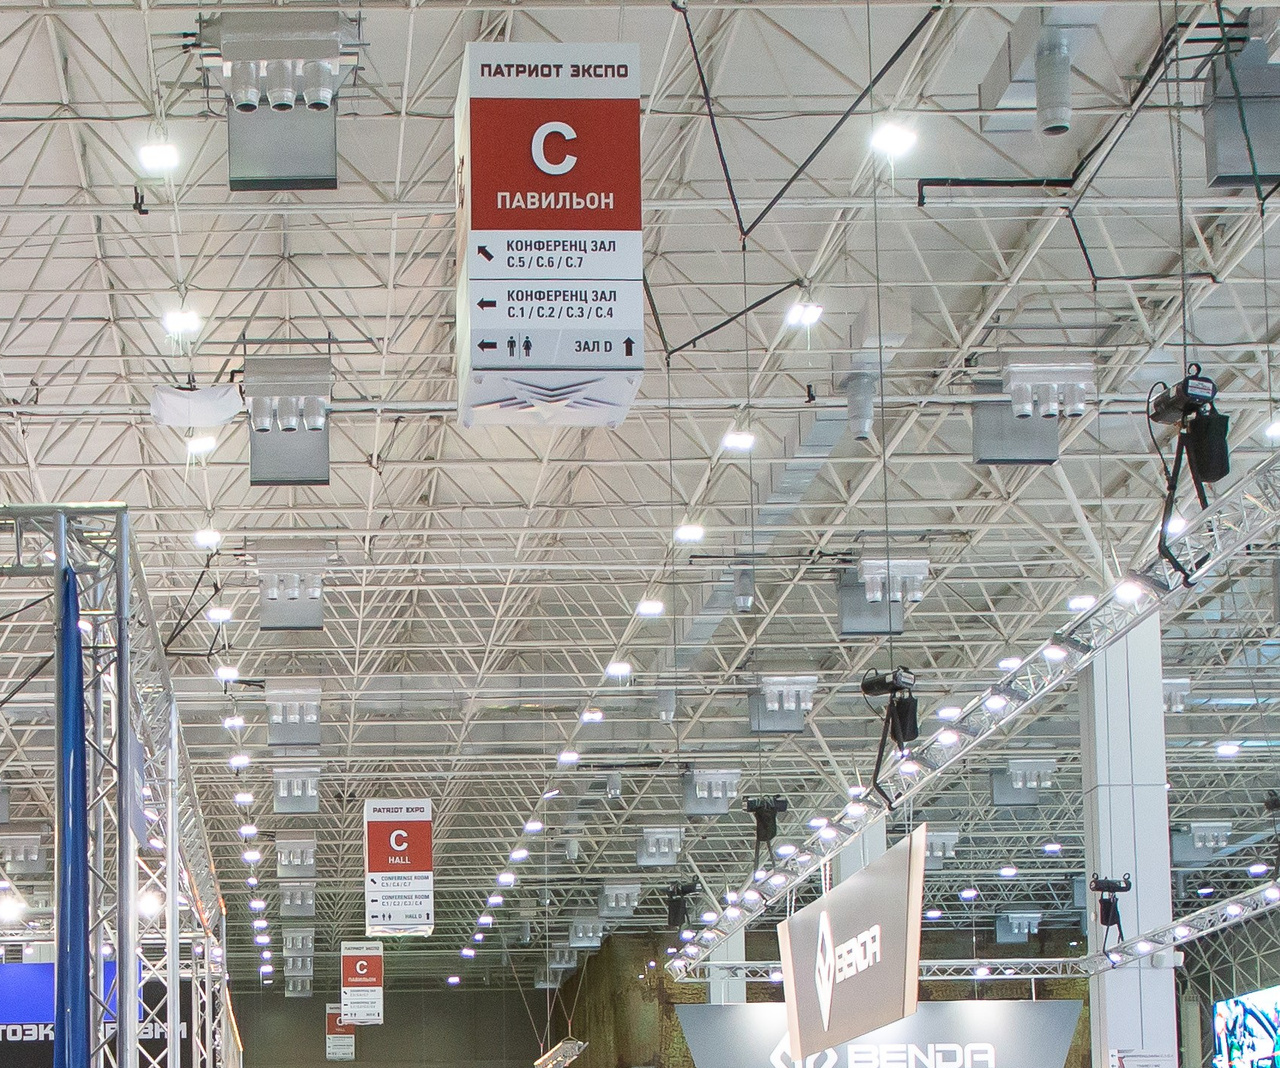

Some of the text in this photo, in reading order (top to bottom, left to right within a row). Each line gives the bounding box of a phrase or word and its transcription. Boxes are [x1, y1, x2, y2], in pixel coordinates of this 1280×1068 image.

[480, 64, 629, 78] ПАТРИОТ ЭКСПО
[497, 192, 614, 210] ПАВИЛЬОН
[506, 240, 617, 254] КОНФЕРЕНЦ ЗАЛ
[507, 289, 617, 304] КОНФЕРЕНЦ ЗАЛ
[574, 341, 613, 353] ЗАЛ D
[389, 829, 409, 852] C
[388, 856, 411, 864] HALL
[835, 924, 881, 984] BENDA
